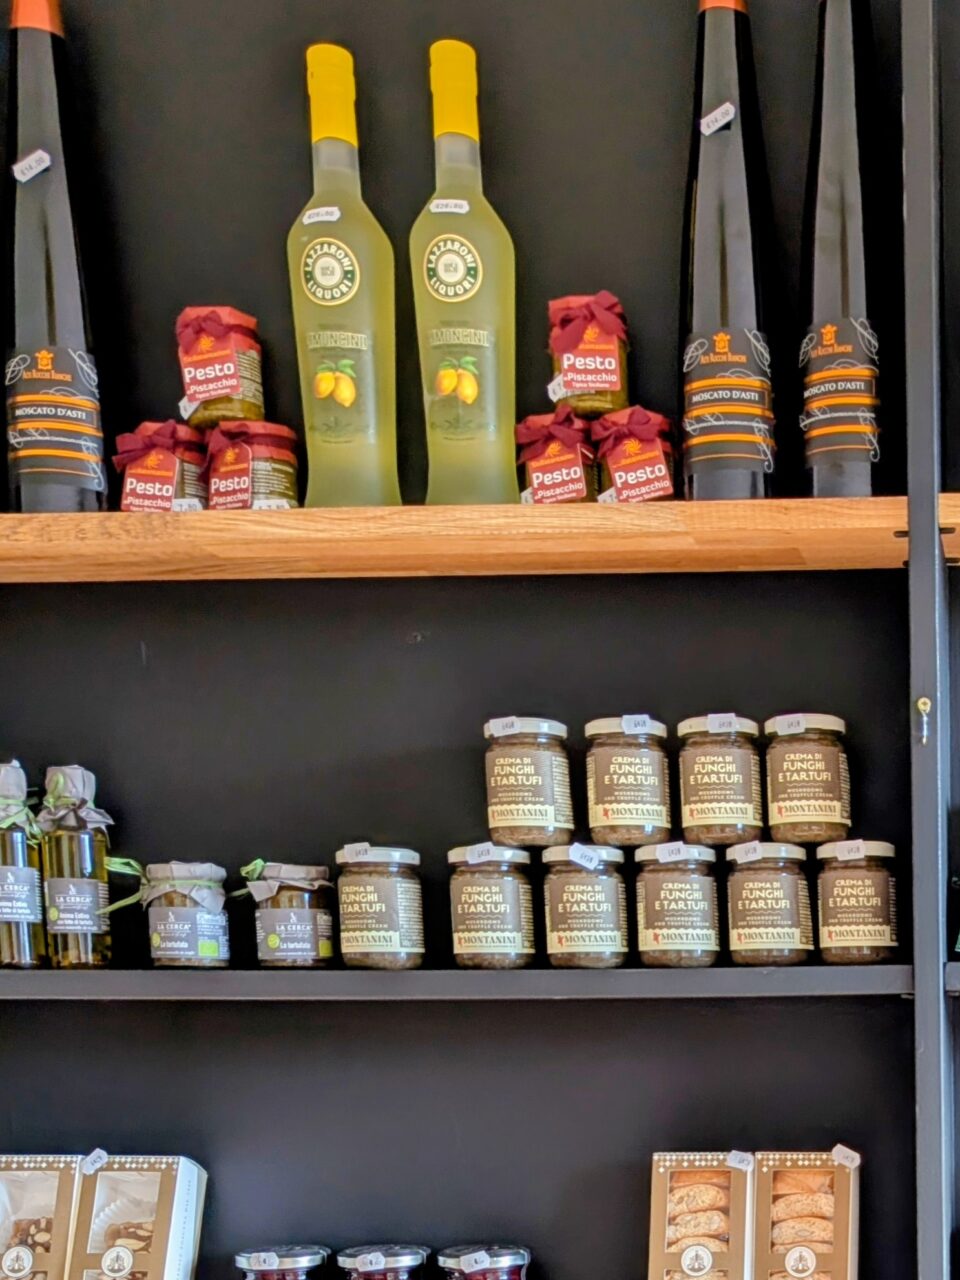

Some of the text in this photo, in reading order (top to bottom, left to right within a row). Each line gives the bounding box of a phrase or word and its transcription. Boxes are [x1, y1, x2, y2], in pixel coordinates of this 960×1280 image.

[304, 243, 354, 271] LAZZARONI
[427, 240, 476, 268] LAZZARONI
[307, 275, 353, 300] LIQUORI
[430, 275, 475, 297] LIQUORI
[563, 354, 616, 371] Pesto
[184, 364, 234, 382] Pesto
[568, 372, 616, 382] Pistacchio
[190, 378, 237, 394] Pistacchio
[838, 382, 864, 391] D'ASTI
[692, 390, 759, 403] MOSCATO D'ASTI
[16, 406, 56, 416] MOSCATO
[532, 466, 581, 488] Pesto
[615, 462, 666, 486] Pesto
[126, 478, 172, 496] Pesto
[212, 476, 248, 492] Pesto
[537, 481, 583, 499] Pistacchio
[128, 496, 171, 508] Pistacchio
[213, 492, 249, 506] Pistacchio
[494, 765, 535, 775] FUNGHI
[610, 764, 652, 774] FUNGHI
[694, 763, 736, 773] FUNGHI
[783, 761, 825, 771] FUNGHI
[496, 776, 542, 786] TARTUFI
[613, 775, 658, 786] TARTUFI
[697, 774, 742, 784] TARTUFI
[786, 772, 831, 781] TARTUFI
[461, 893, 503, 903] FUNGHI
[463, 904, 509, 913] TARTUFI
